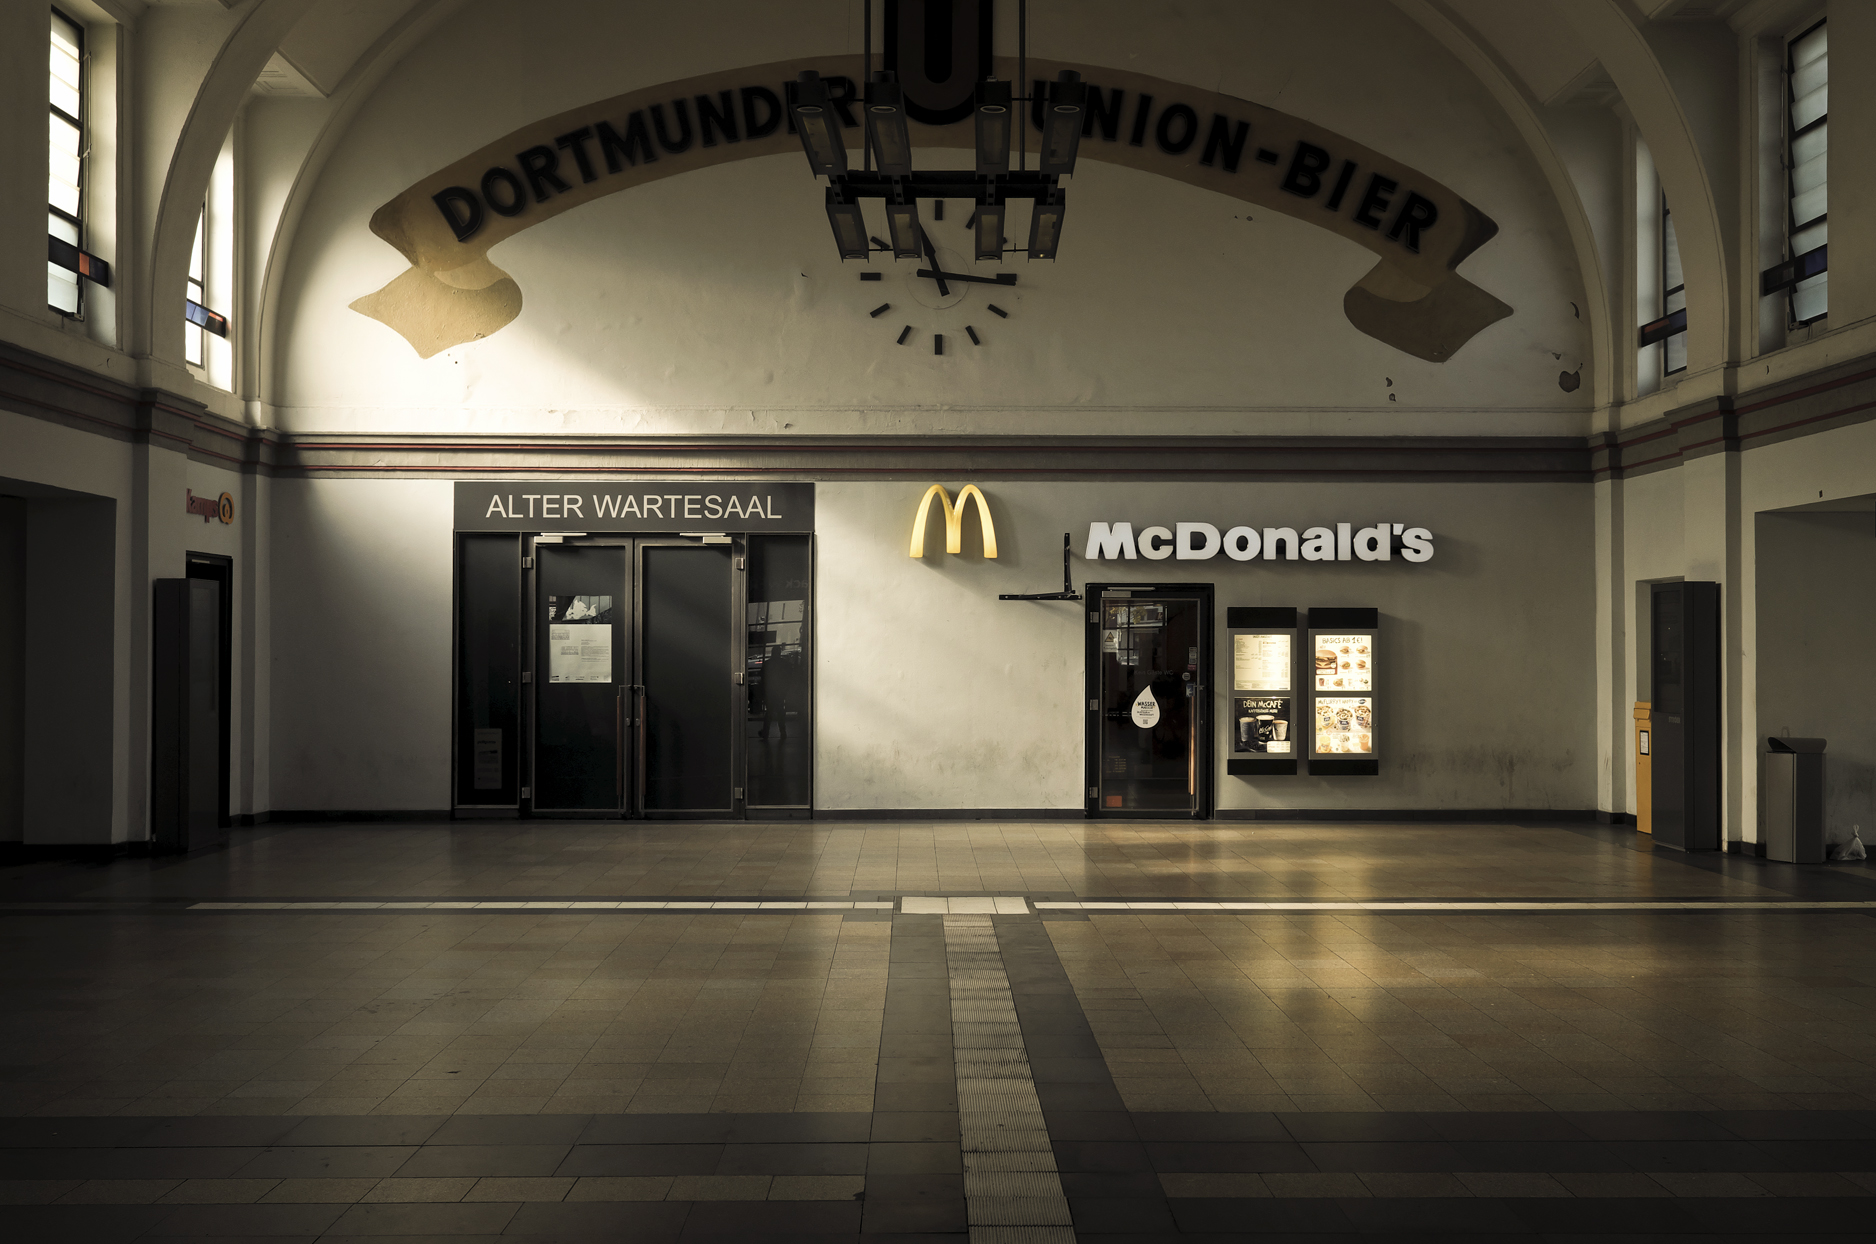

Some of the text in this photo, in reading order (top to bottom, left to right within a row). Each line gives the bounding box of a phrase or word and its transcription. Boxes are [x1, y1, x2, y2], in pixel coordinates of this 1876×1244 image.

[486, 494, 783, 519] ALTER WARTESAAL
[1085, 521, 1435, 563] McDonald's
